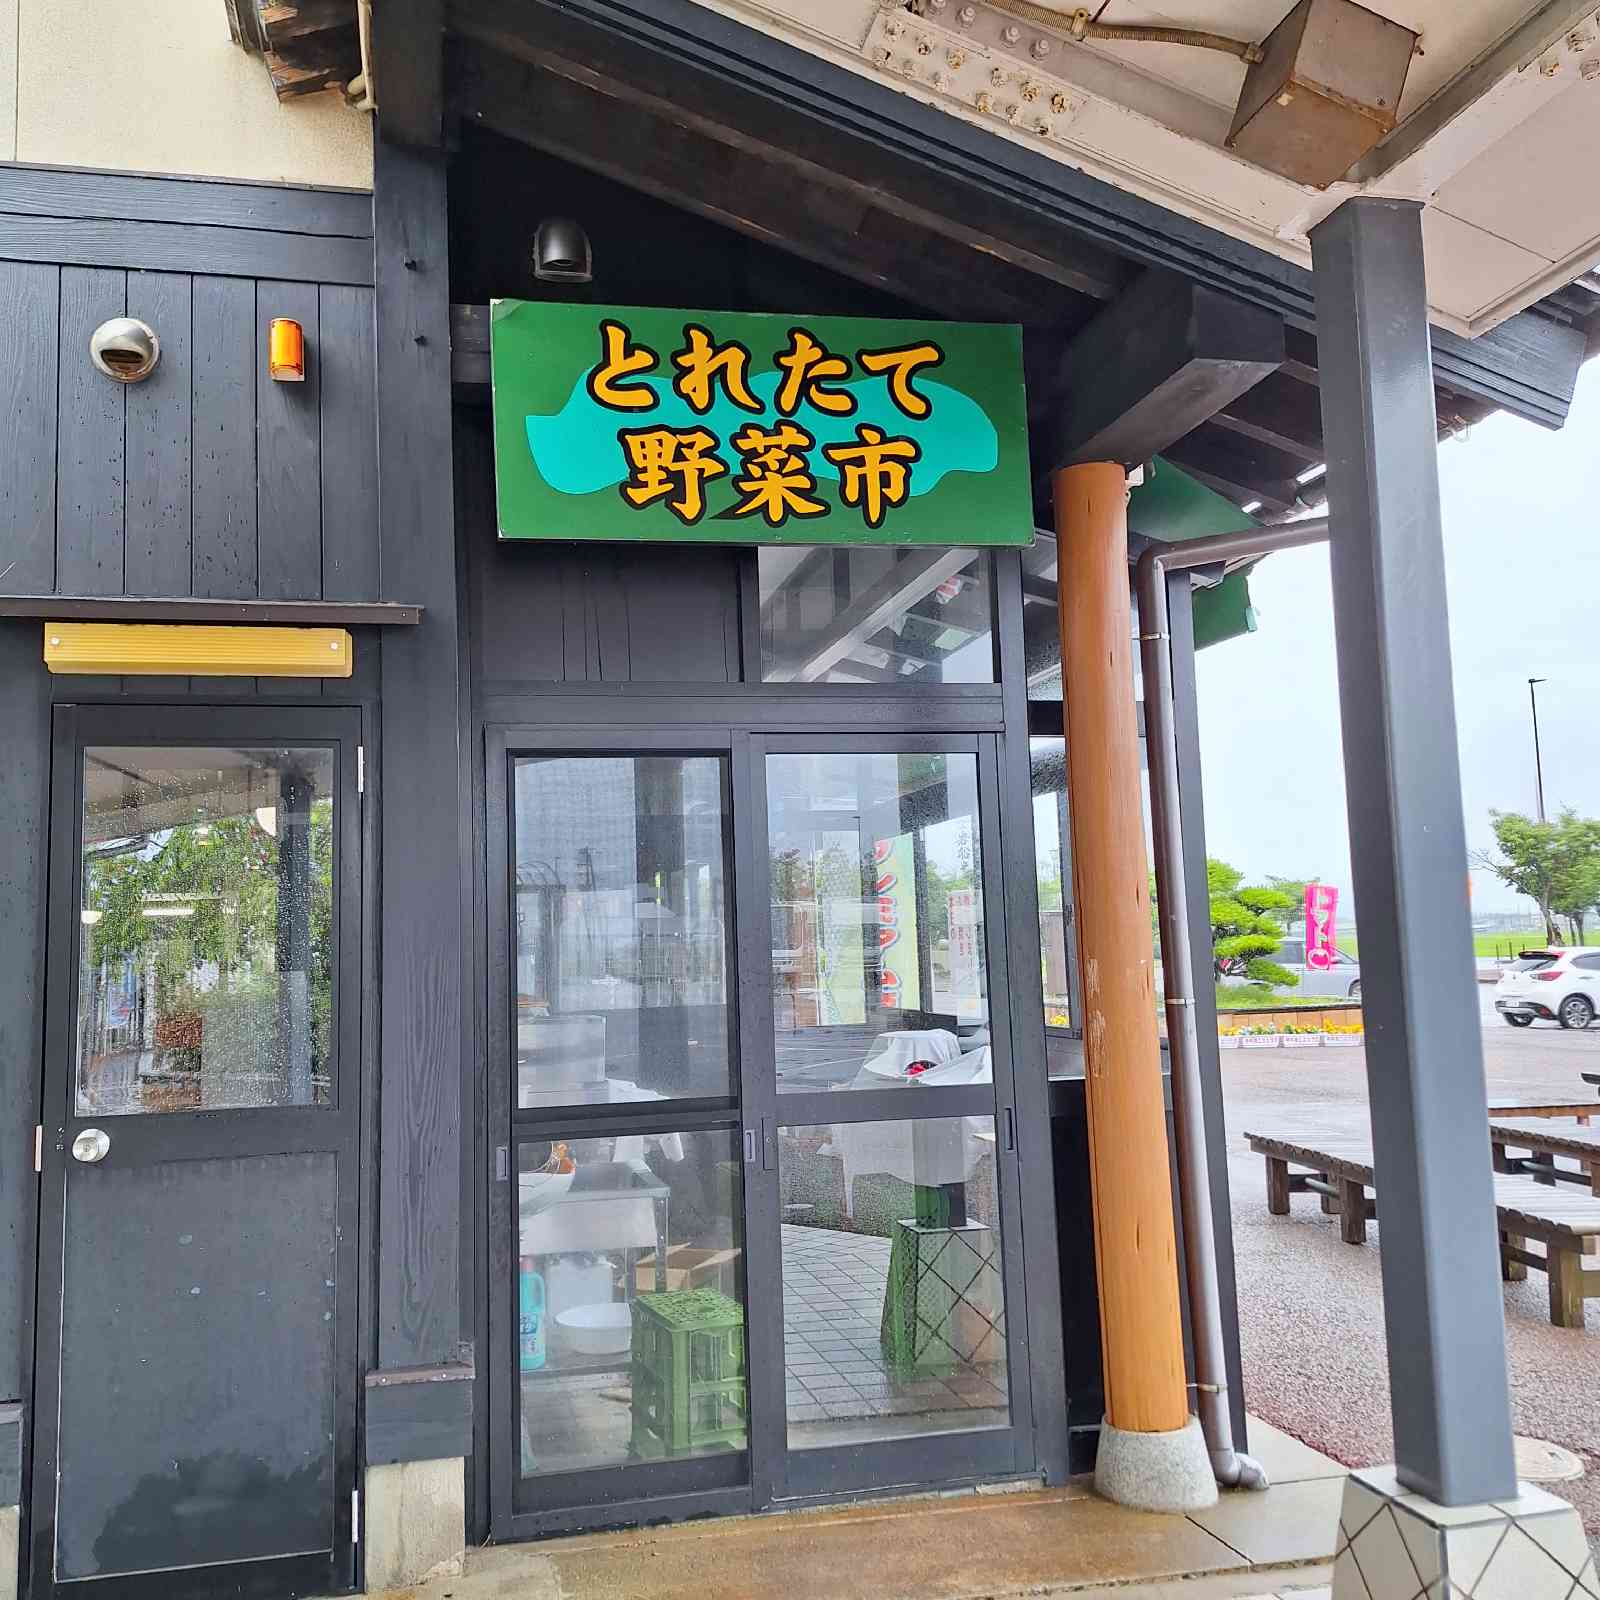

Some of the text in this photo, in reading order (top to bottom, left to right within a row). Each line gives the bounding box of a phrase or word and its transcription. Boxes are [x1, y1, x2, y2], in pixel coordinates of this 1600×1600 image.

[588, 320, 943, 419] とれたて
[619, 421, 920, 528] 野菜市
